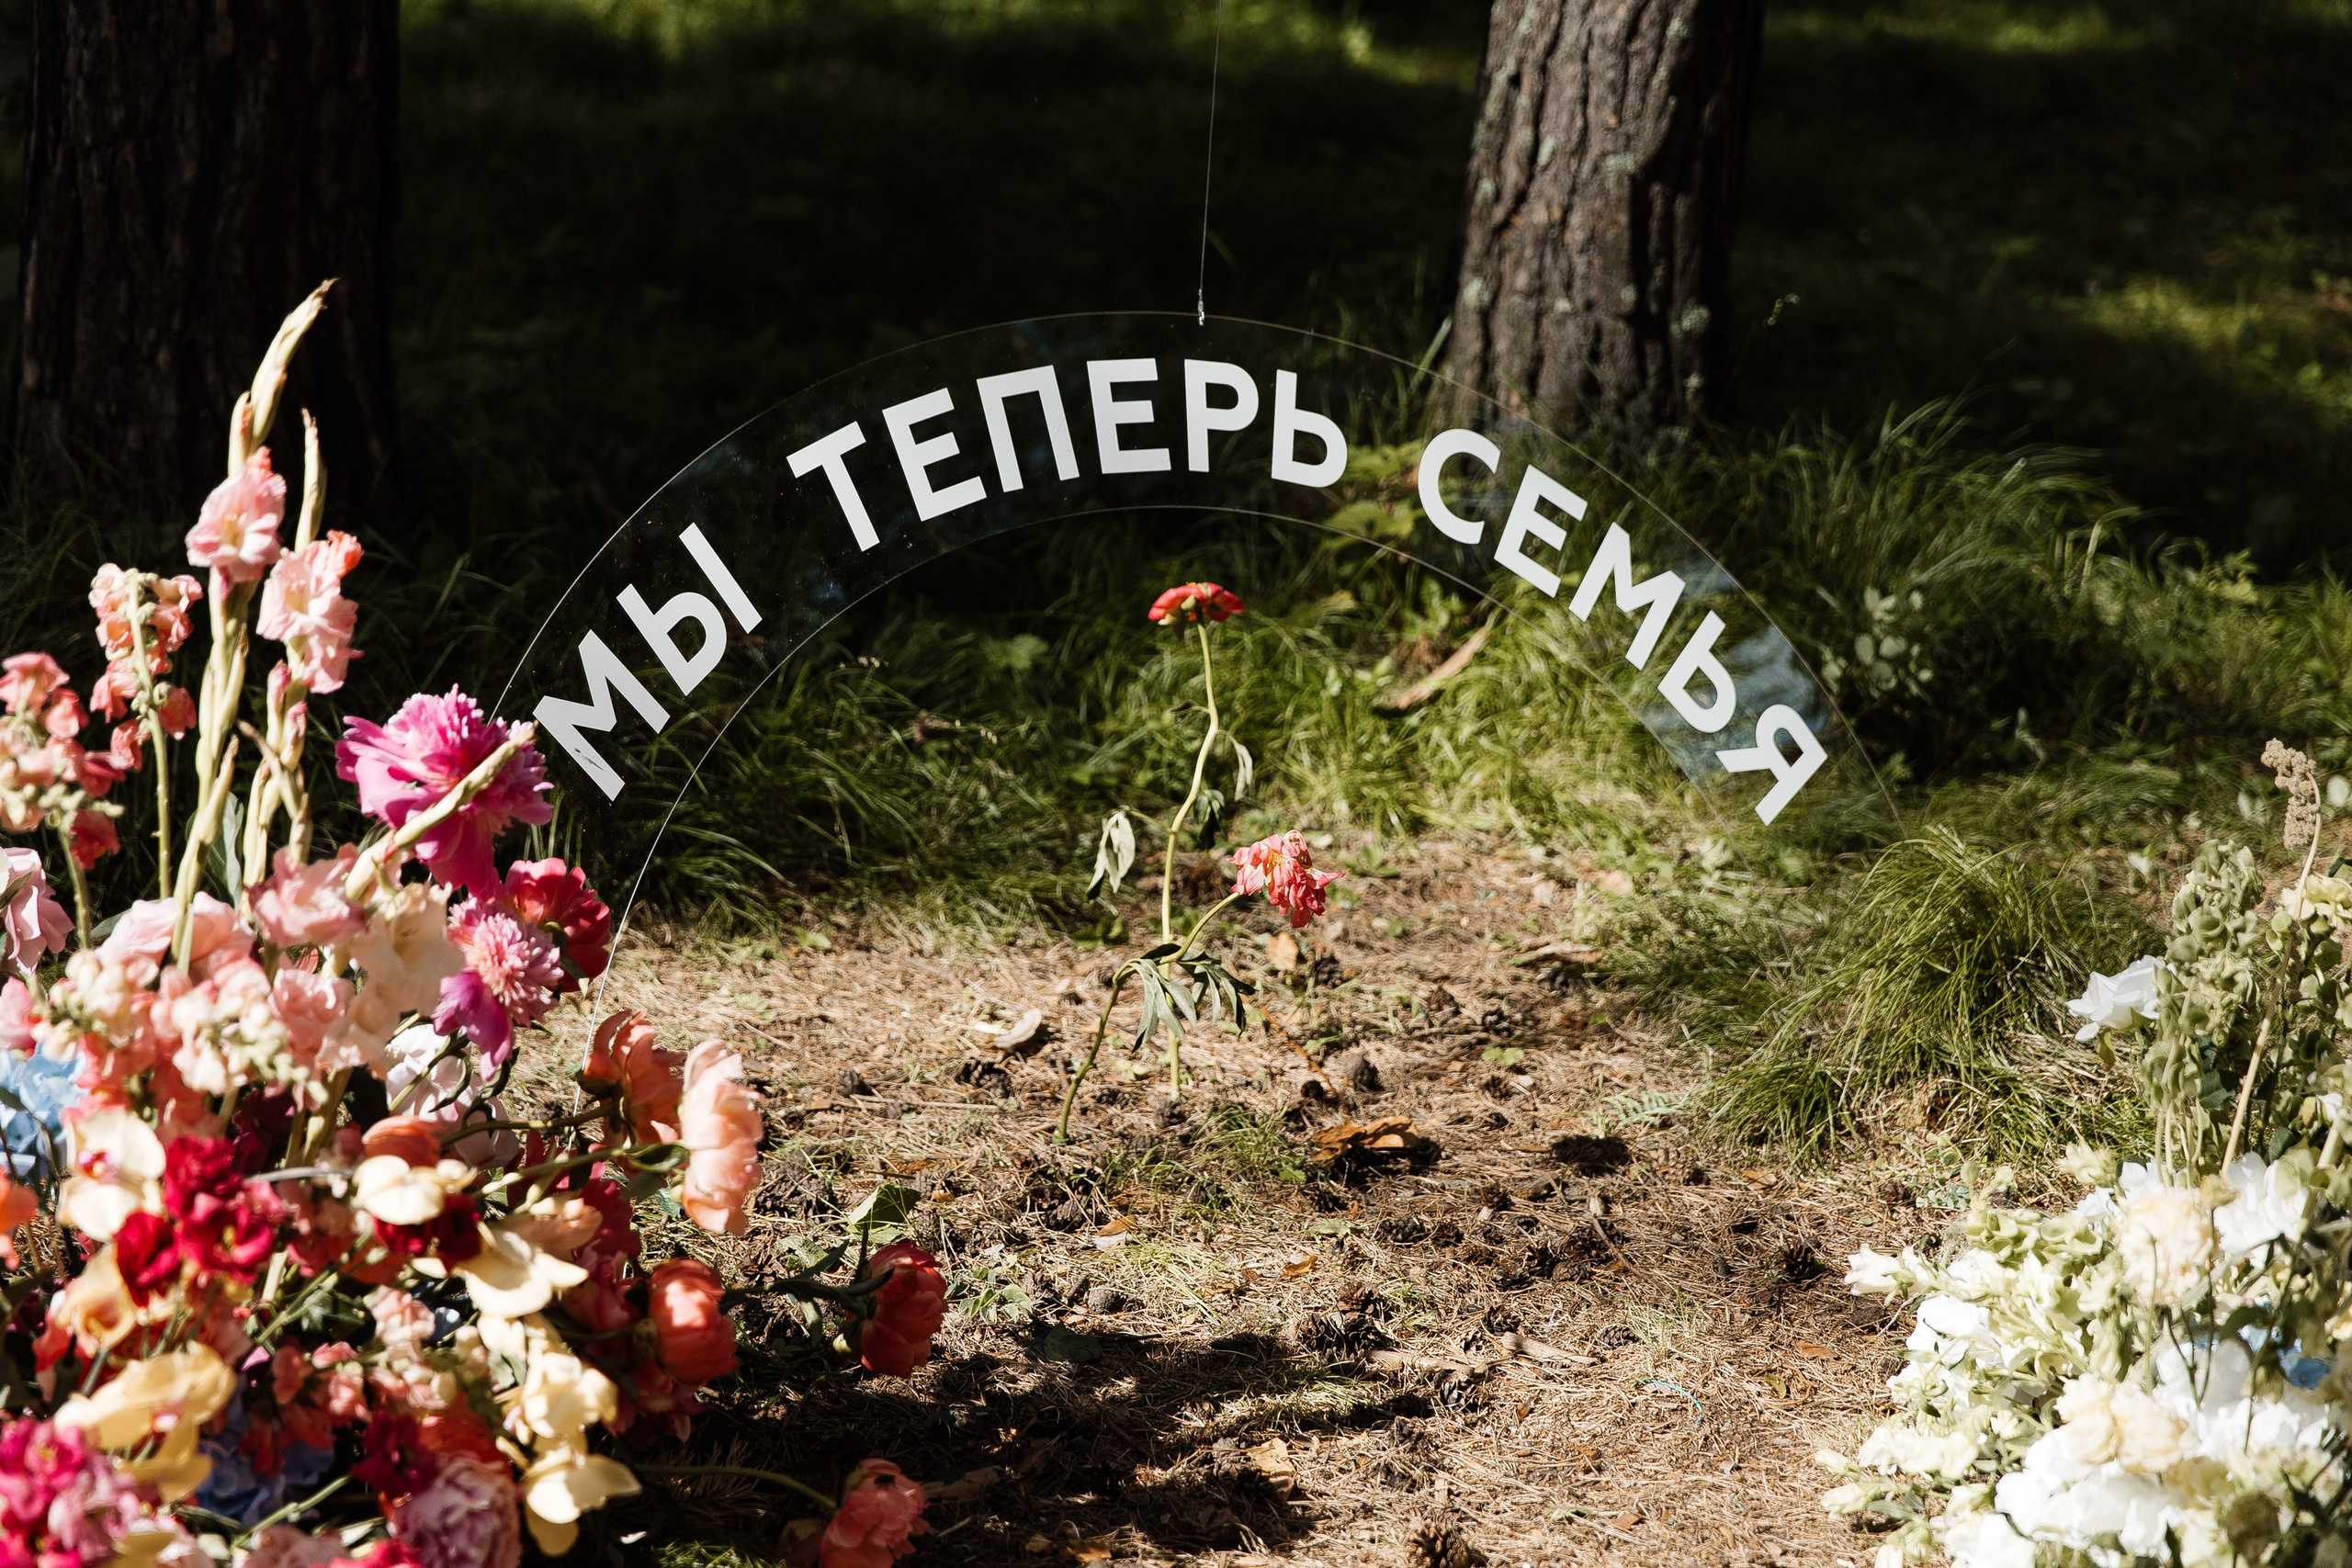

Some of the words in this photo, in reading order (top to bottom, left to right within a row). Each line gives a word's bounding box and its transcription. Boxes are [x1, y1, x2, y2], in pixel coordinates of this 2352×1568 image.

[533, 523, 763, 801] МЫ
[786, 358, 1348, 551] ТЕПЕРЬ
[1418, 428, 1827, 826] СЕМЬЯ
